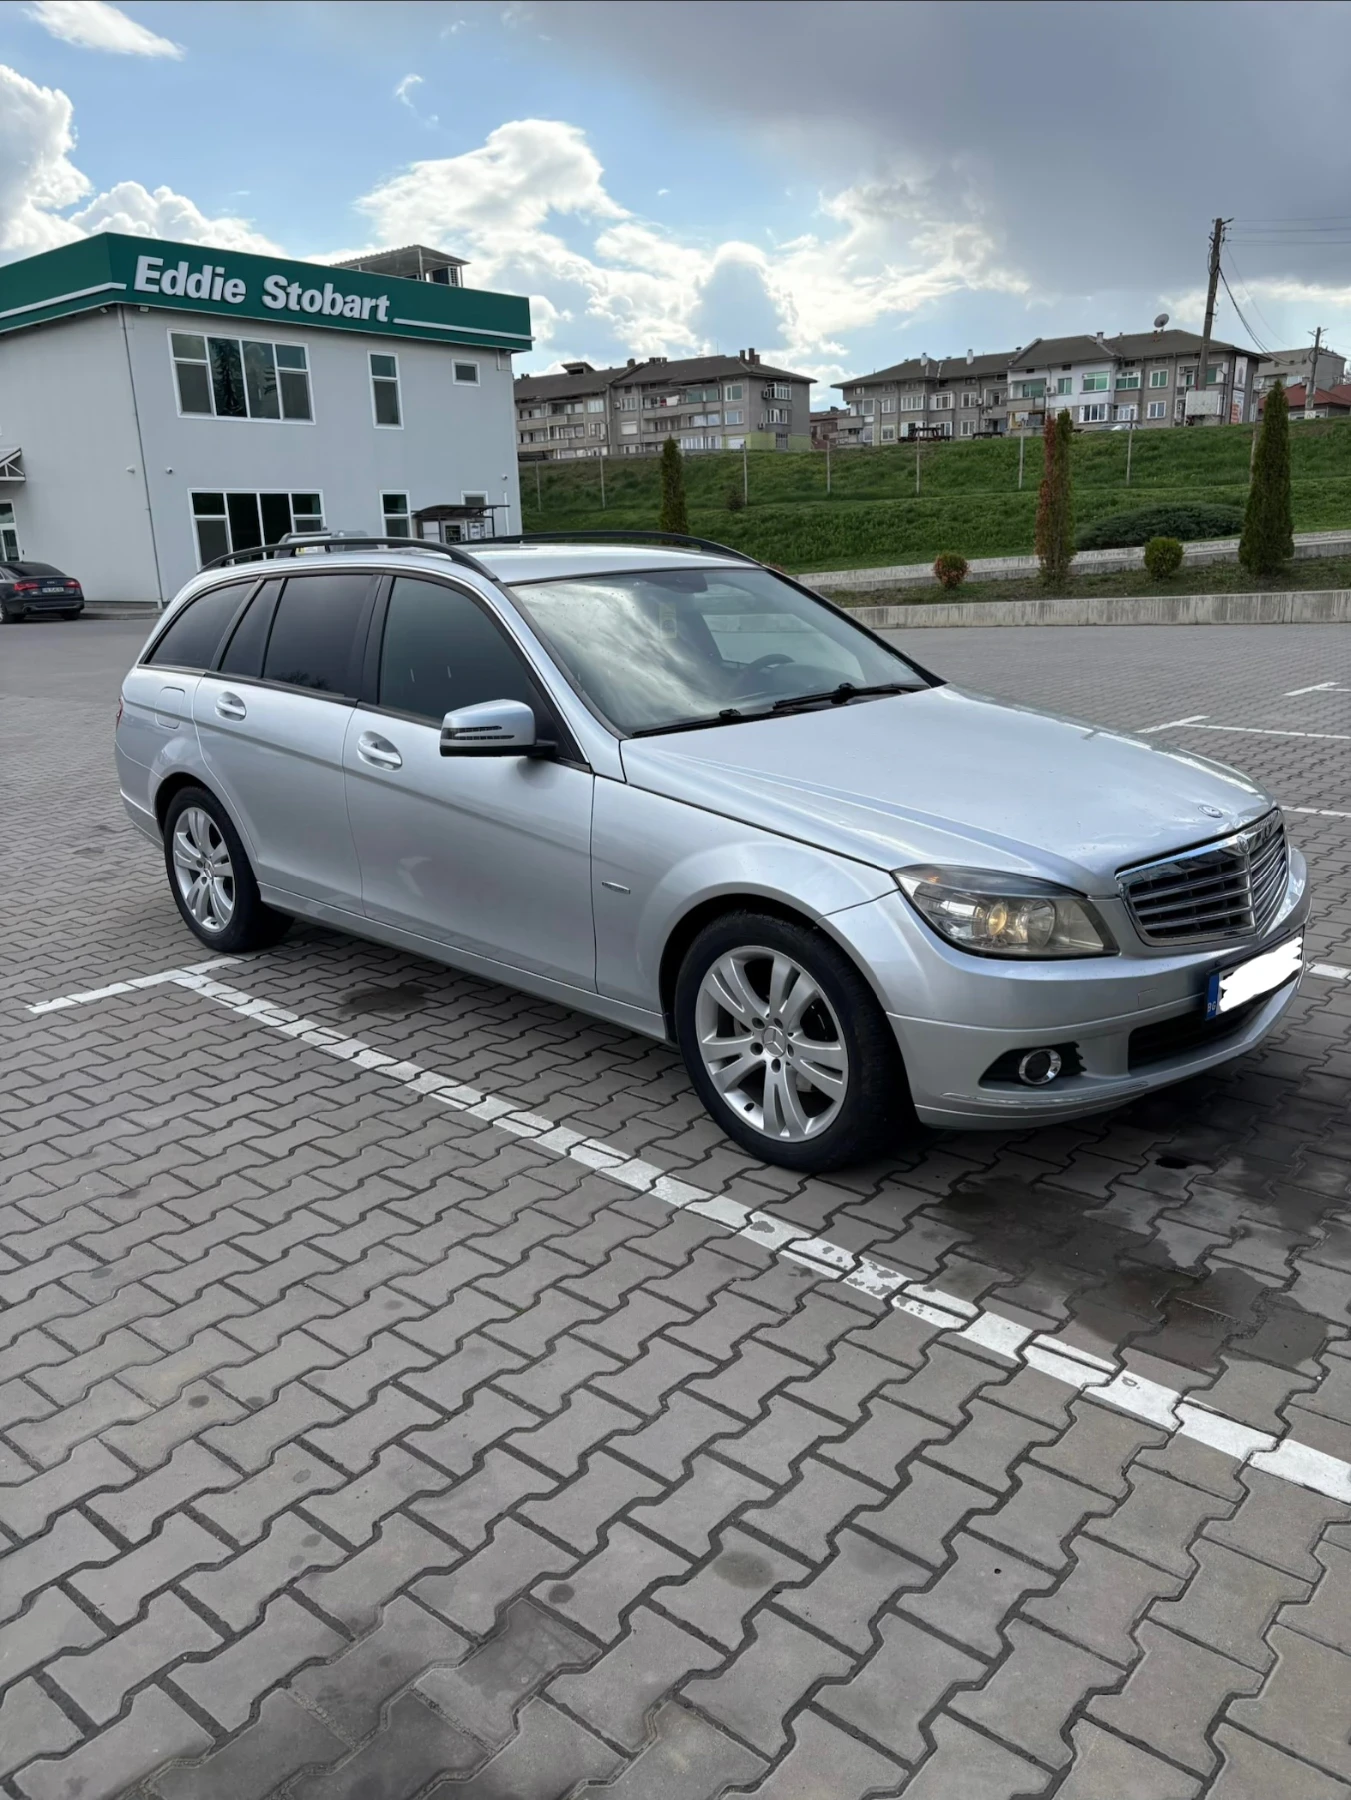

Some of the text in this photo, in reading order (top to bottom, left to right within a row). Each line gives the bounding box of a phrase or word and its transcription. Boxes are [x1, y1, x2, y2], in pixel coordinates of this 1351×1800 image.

[134, 255, 390, 322] Eddie Stobart
[1207, 1001, 1216, 1012] BG
